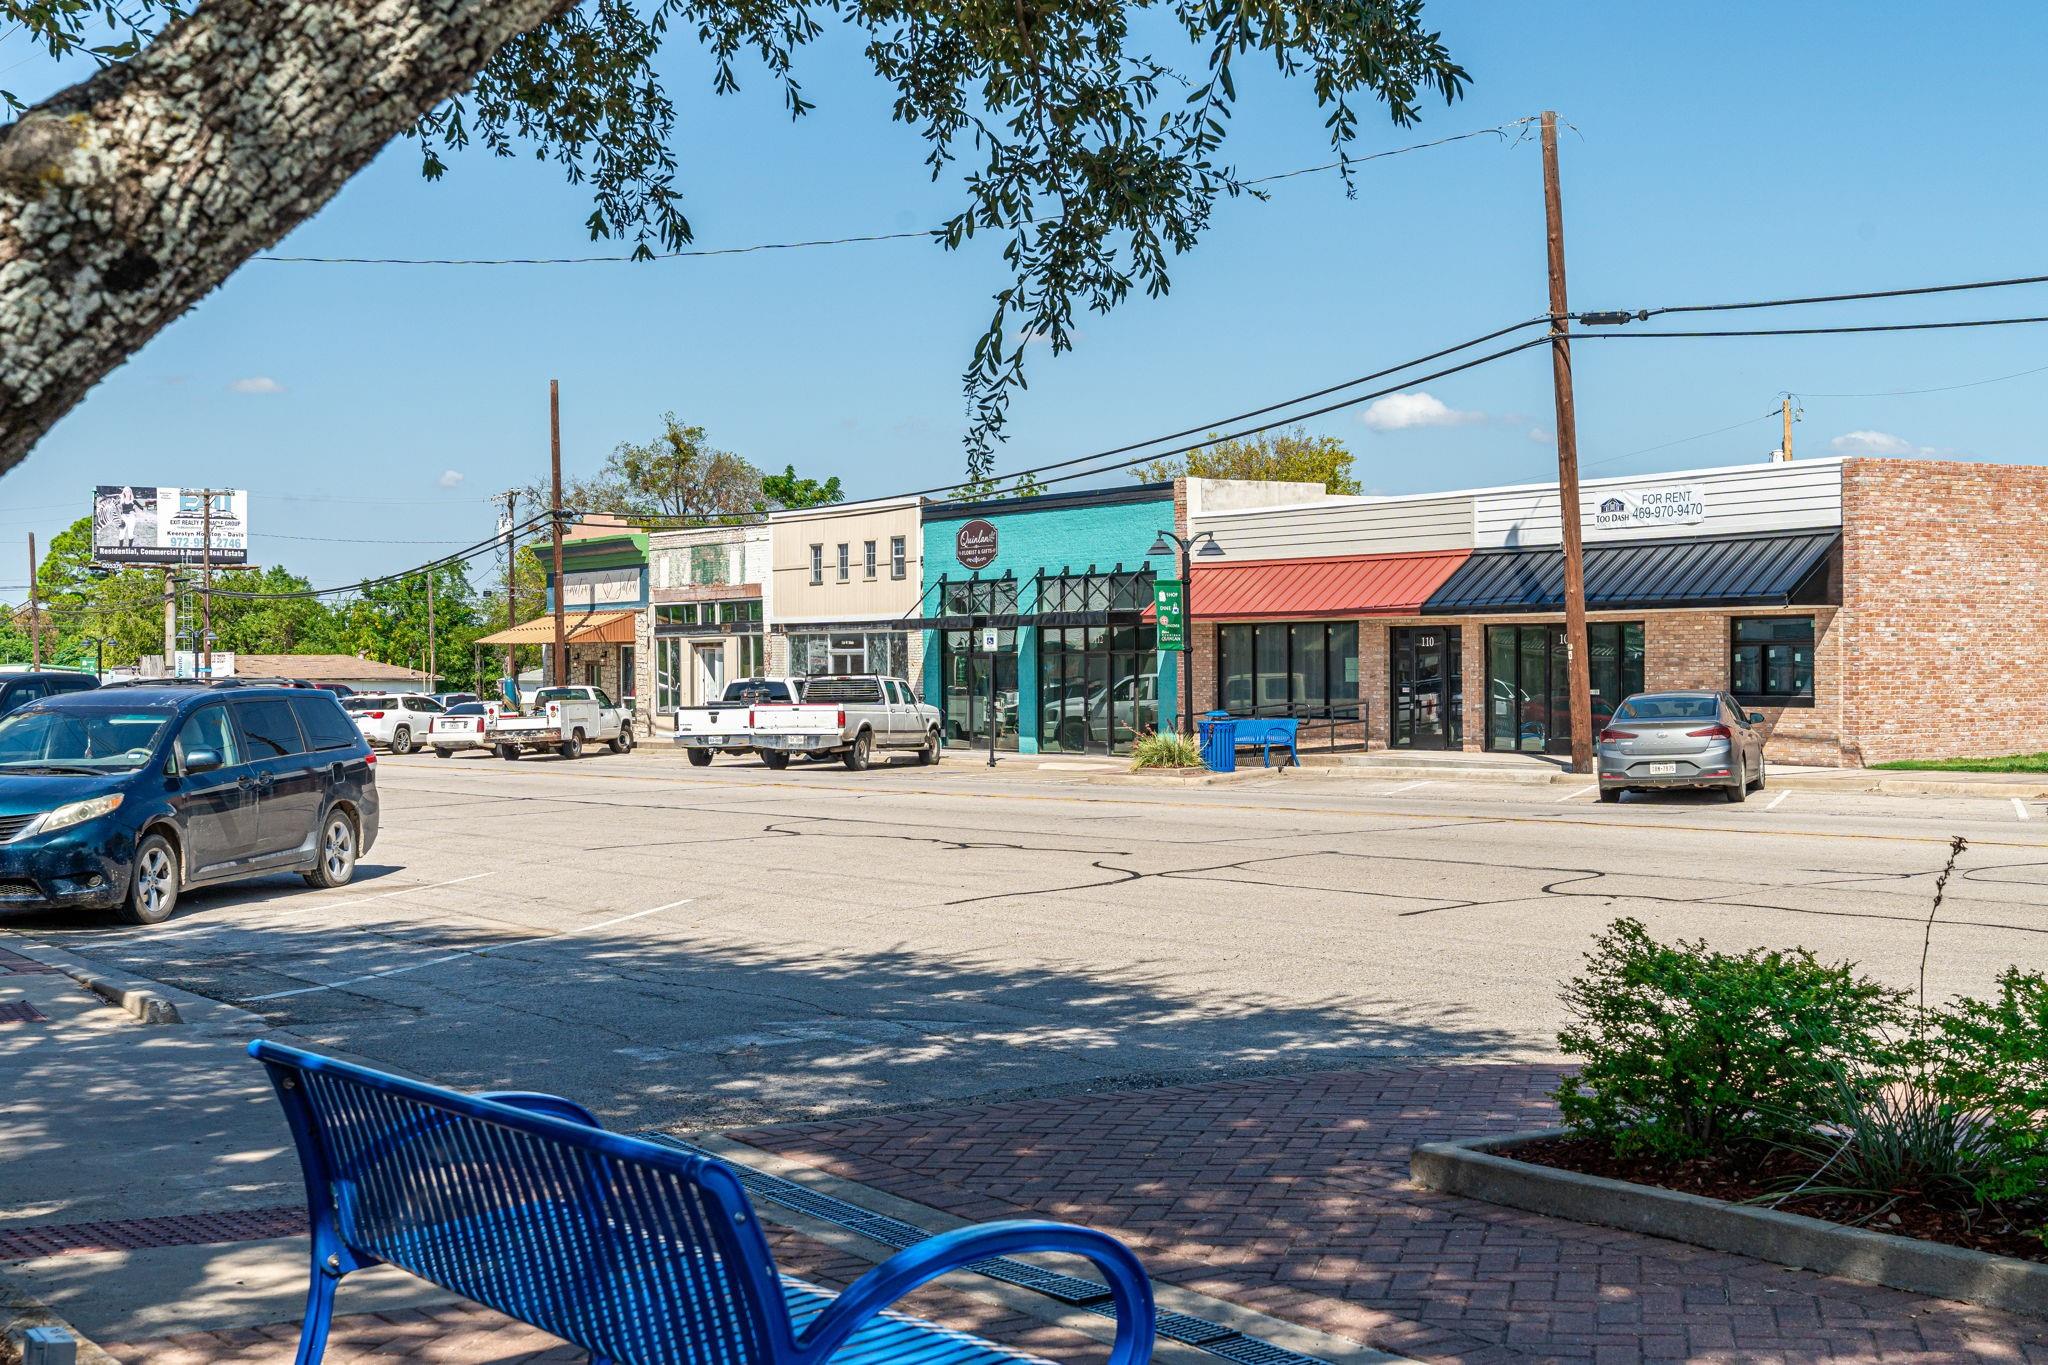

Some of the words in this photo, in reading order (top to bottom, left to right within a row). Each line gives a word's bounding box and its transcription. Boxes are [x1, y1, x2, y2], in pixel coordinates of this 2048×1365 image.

[1641, 493, 1662, 505] FOR
[1665, 491, 1692, 503] RENT
[1632, 502, 1703, 519] 469-970-9470
[1596, 515, 1610, 523] TOO
[1611, 513, 1630, 522] DASH
[960, 529, 990, 548] Quinlan
[99, 547, 139, 556] Residential,
[140, 548, 179, 556] Commercial
[224, 549, 244, 557] Estate
[1421, 636, 1435, 647] 110
[1559, 633, 1567, 645] 10
